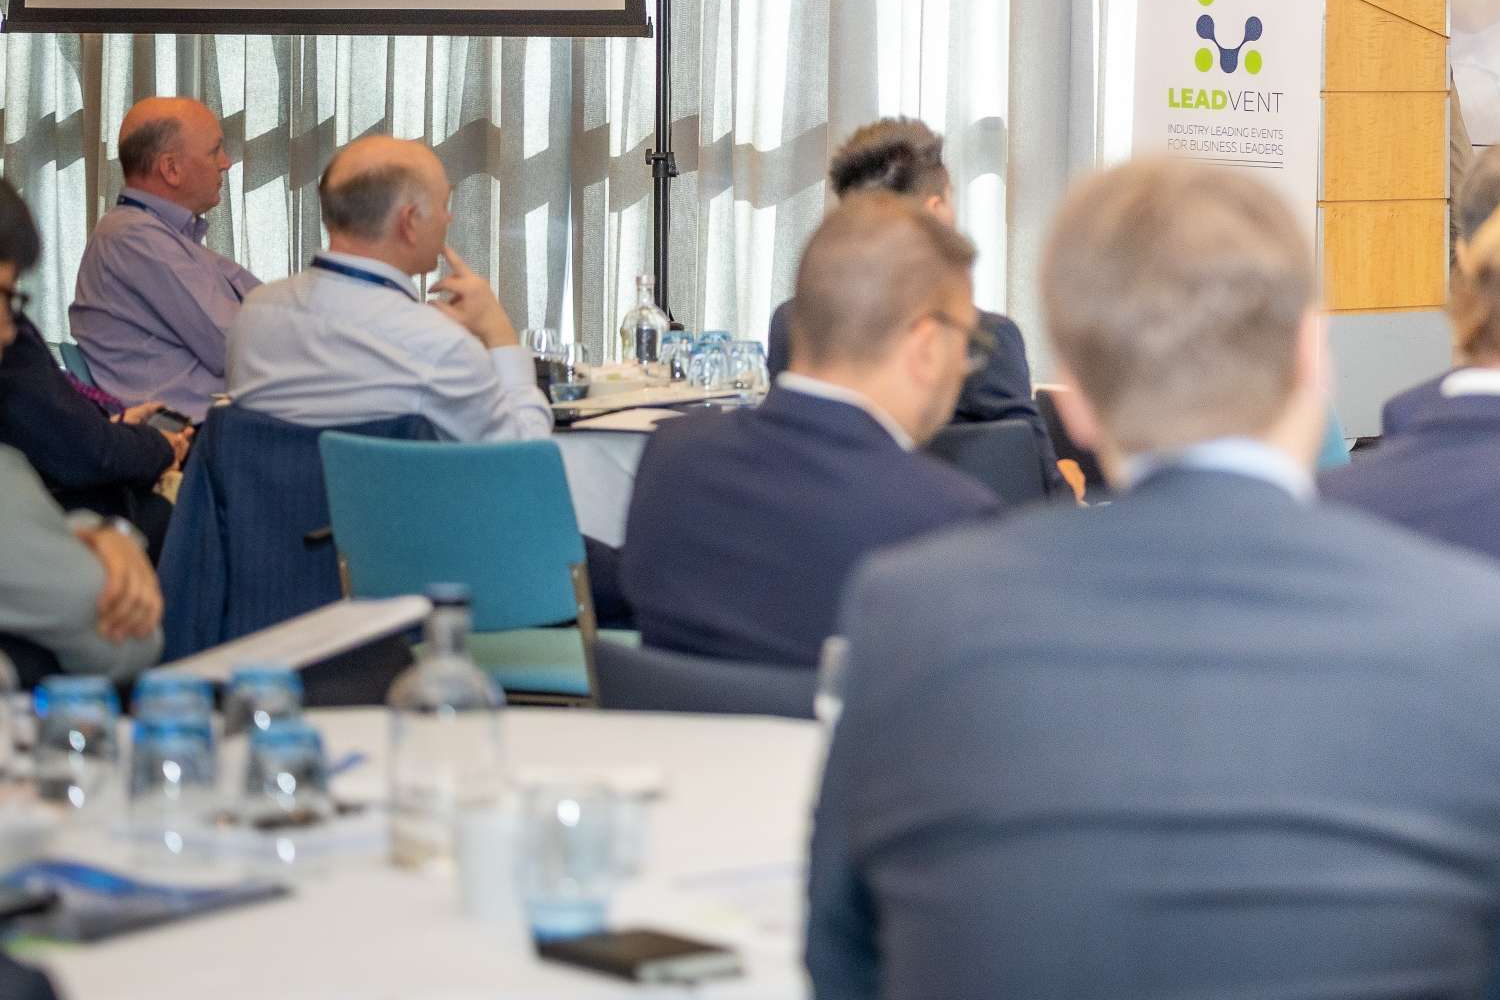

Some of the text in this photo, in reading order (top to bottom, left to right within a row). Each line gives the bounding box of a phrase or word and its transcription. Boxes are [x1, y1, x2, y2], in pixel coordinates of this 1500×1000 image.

[1168, 88, 1284, 113] LEADVENT
[1168, 124, 1284, 140] INDUSTRY LEADING EVENTS
[1168, 138, 1284, 156] FOR BUSINESS LEADERS
